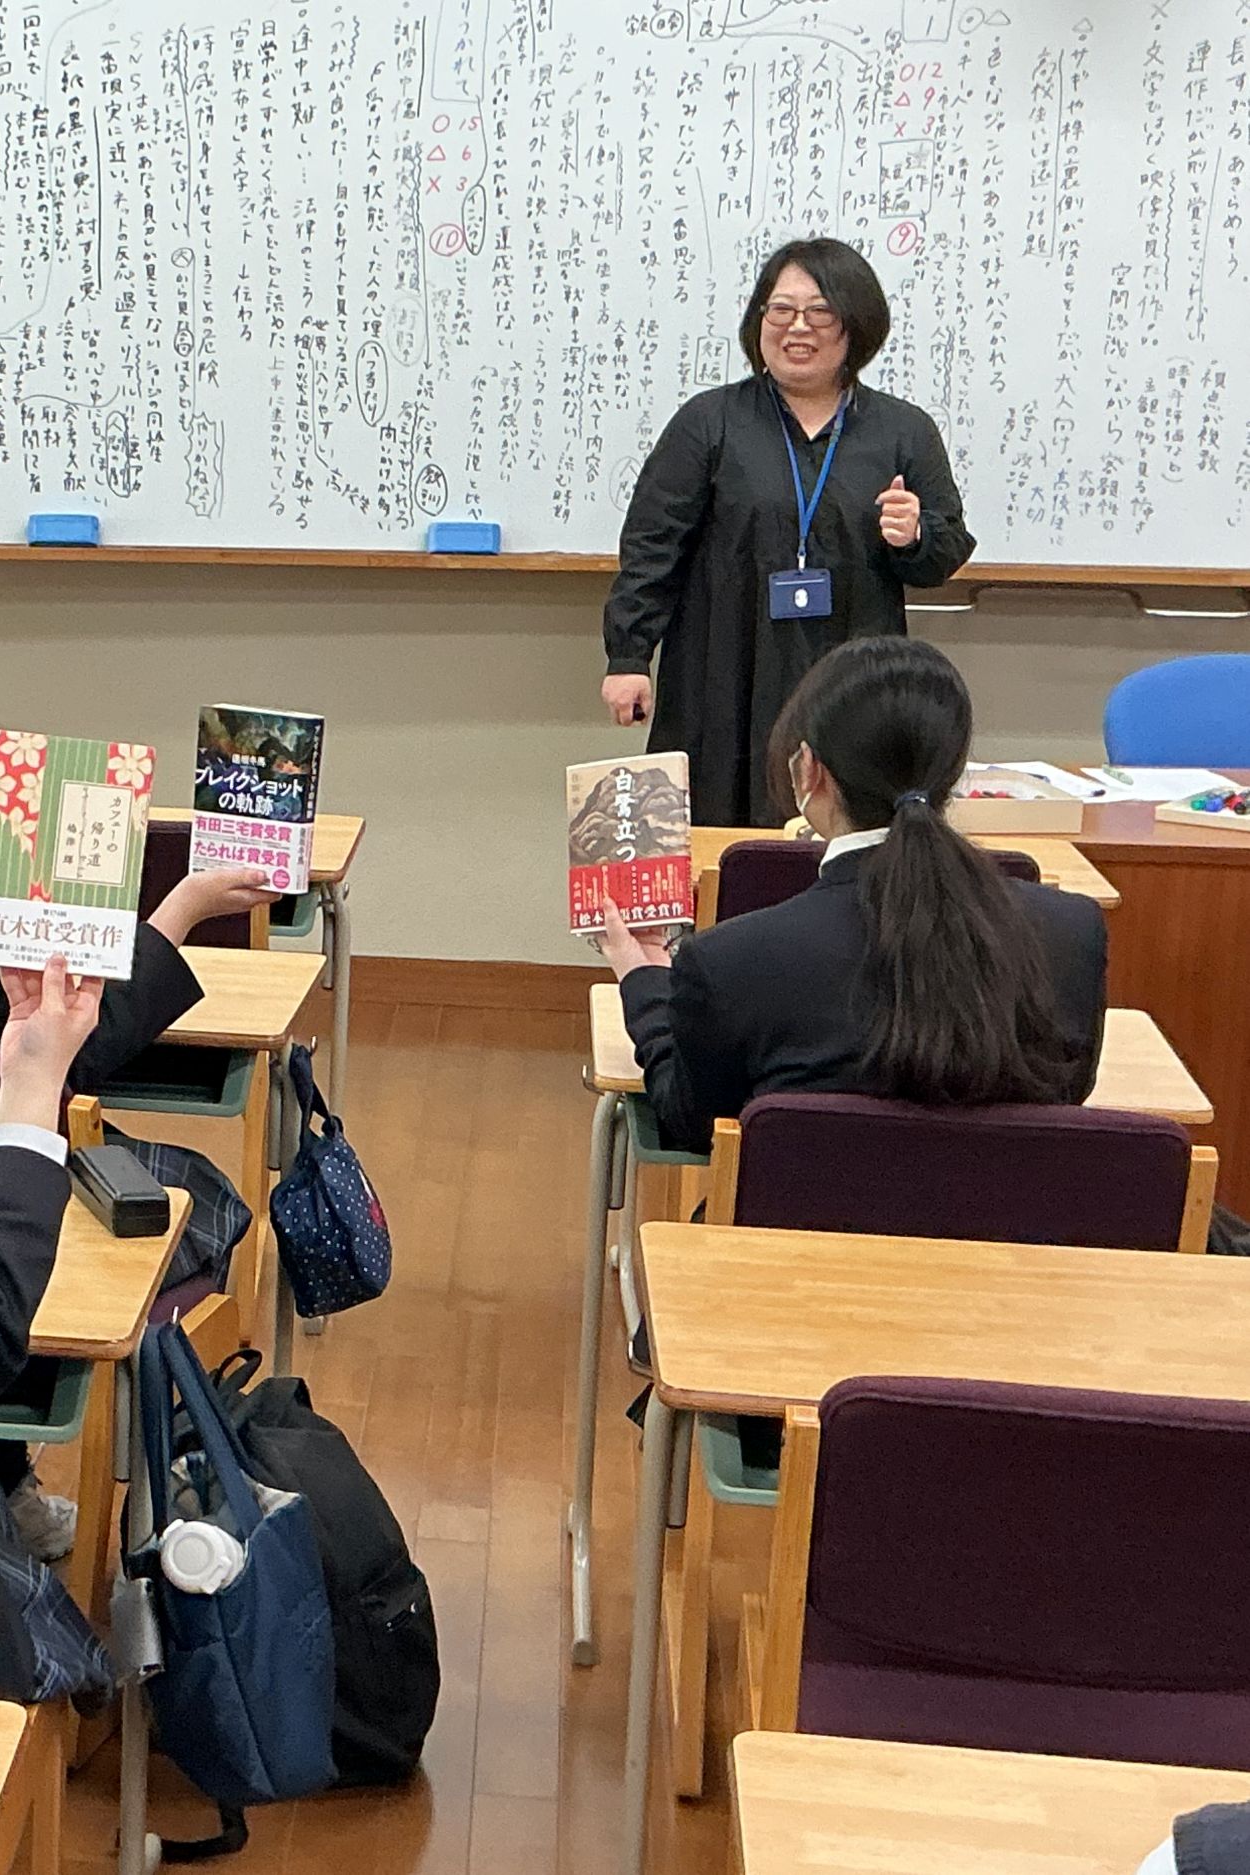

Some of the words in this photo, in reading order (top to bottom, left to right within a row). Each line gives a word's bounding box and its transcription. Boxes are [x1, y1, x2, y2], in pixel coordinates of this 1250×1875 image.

[458, 116, 480, 132] 15
[461, 145, 472, 162] 6
[456, 176, 468, 192] 3
[195, 764, 304, 800] ブレイクショット
[218, 791, 275, 817] の軌跡
[105, 796, 124, 853] カフェーの
